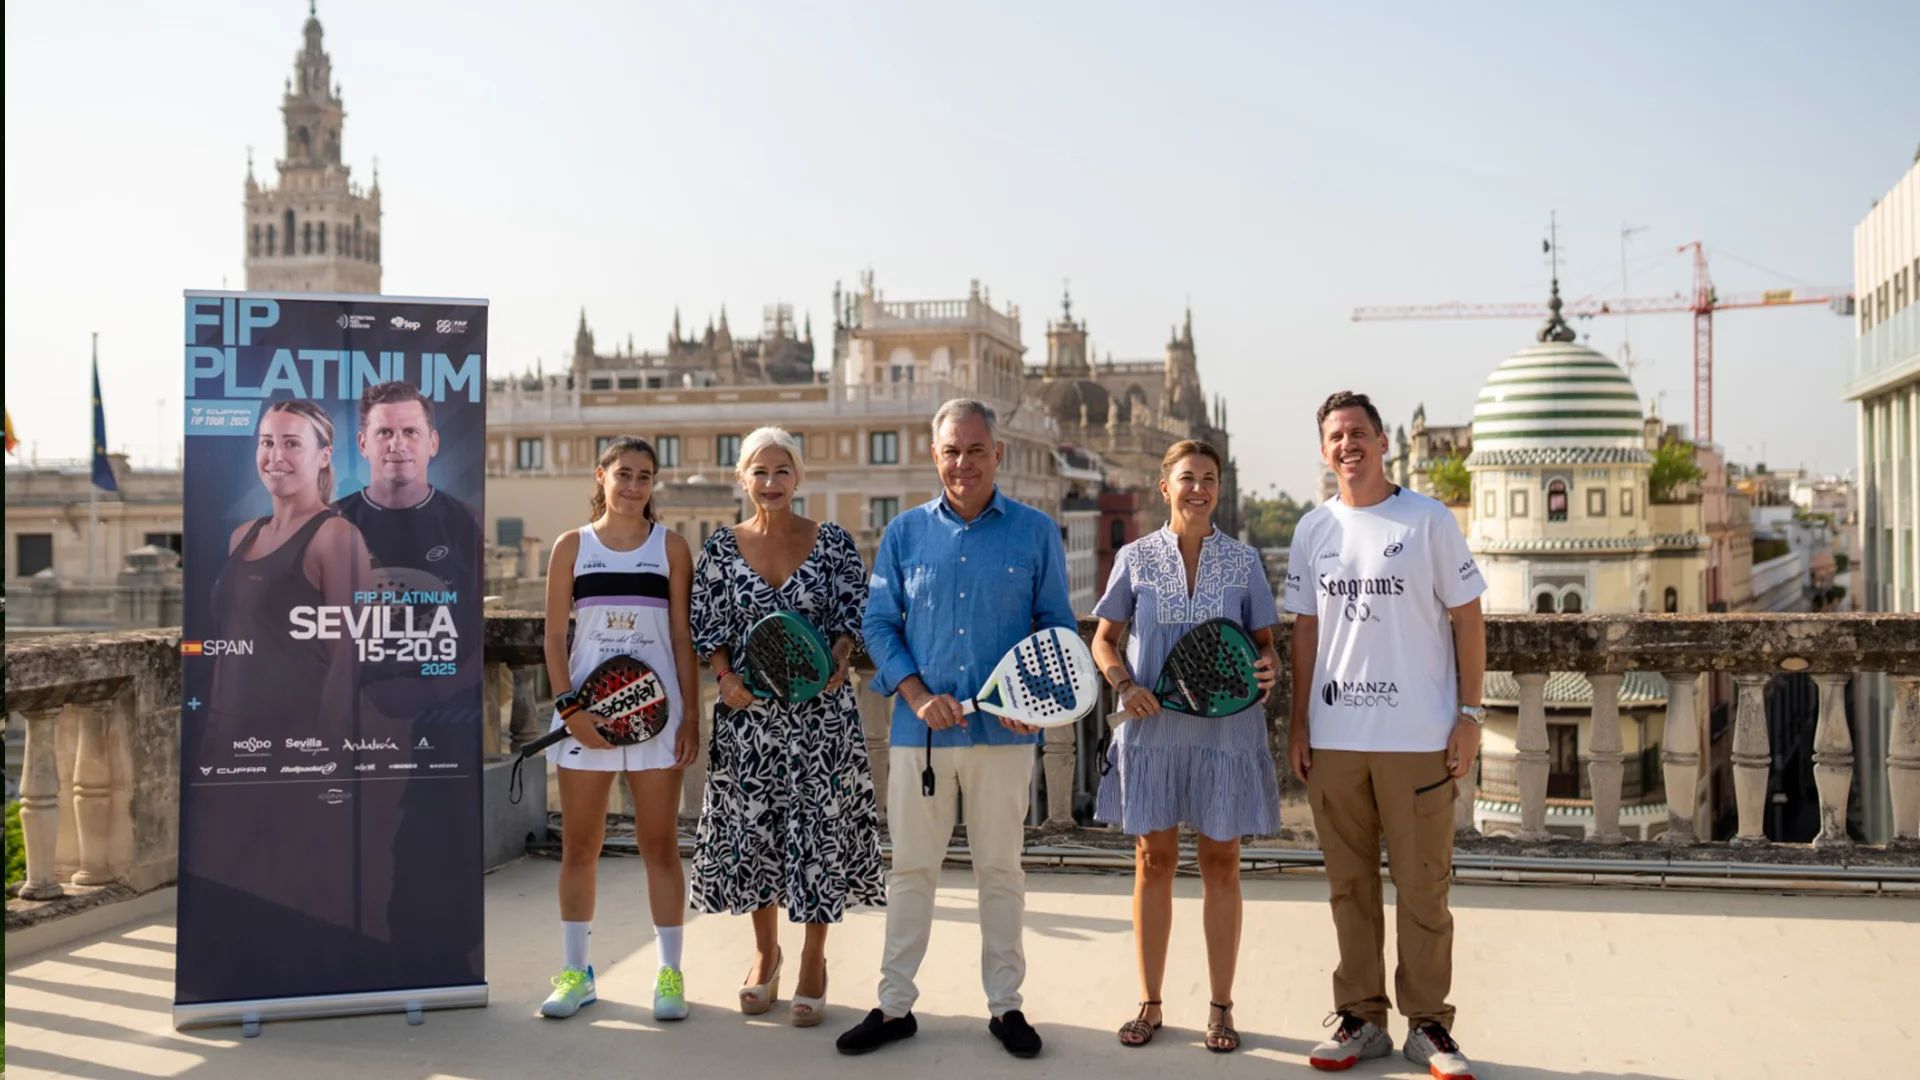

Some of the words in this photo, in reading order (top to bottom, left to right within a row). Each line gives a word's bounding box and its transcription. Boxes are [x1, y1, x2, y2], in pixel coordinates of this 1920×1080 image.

[185, 297, 280, 346] FIP
[185, 346, 481, 403] PLATINUM
[354, 591, 378, 604] FIP
[381, 590, 458, 604] PLATINUM
[289, 605, 459, 640] SEVILLA
[203, 640, 254, 656] SPAIN
[354, 638, 457, 662] 15-20.9
[421, 662, 456, 676] 2025
[1343, 681, 1399, 694] MANZA
[285, 738, 322, 749] Sevilla
